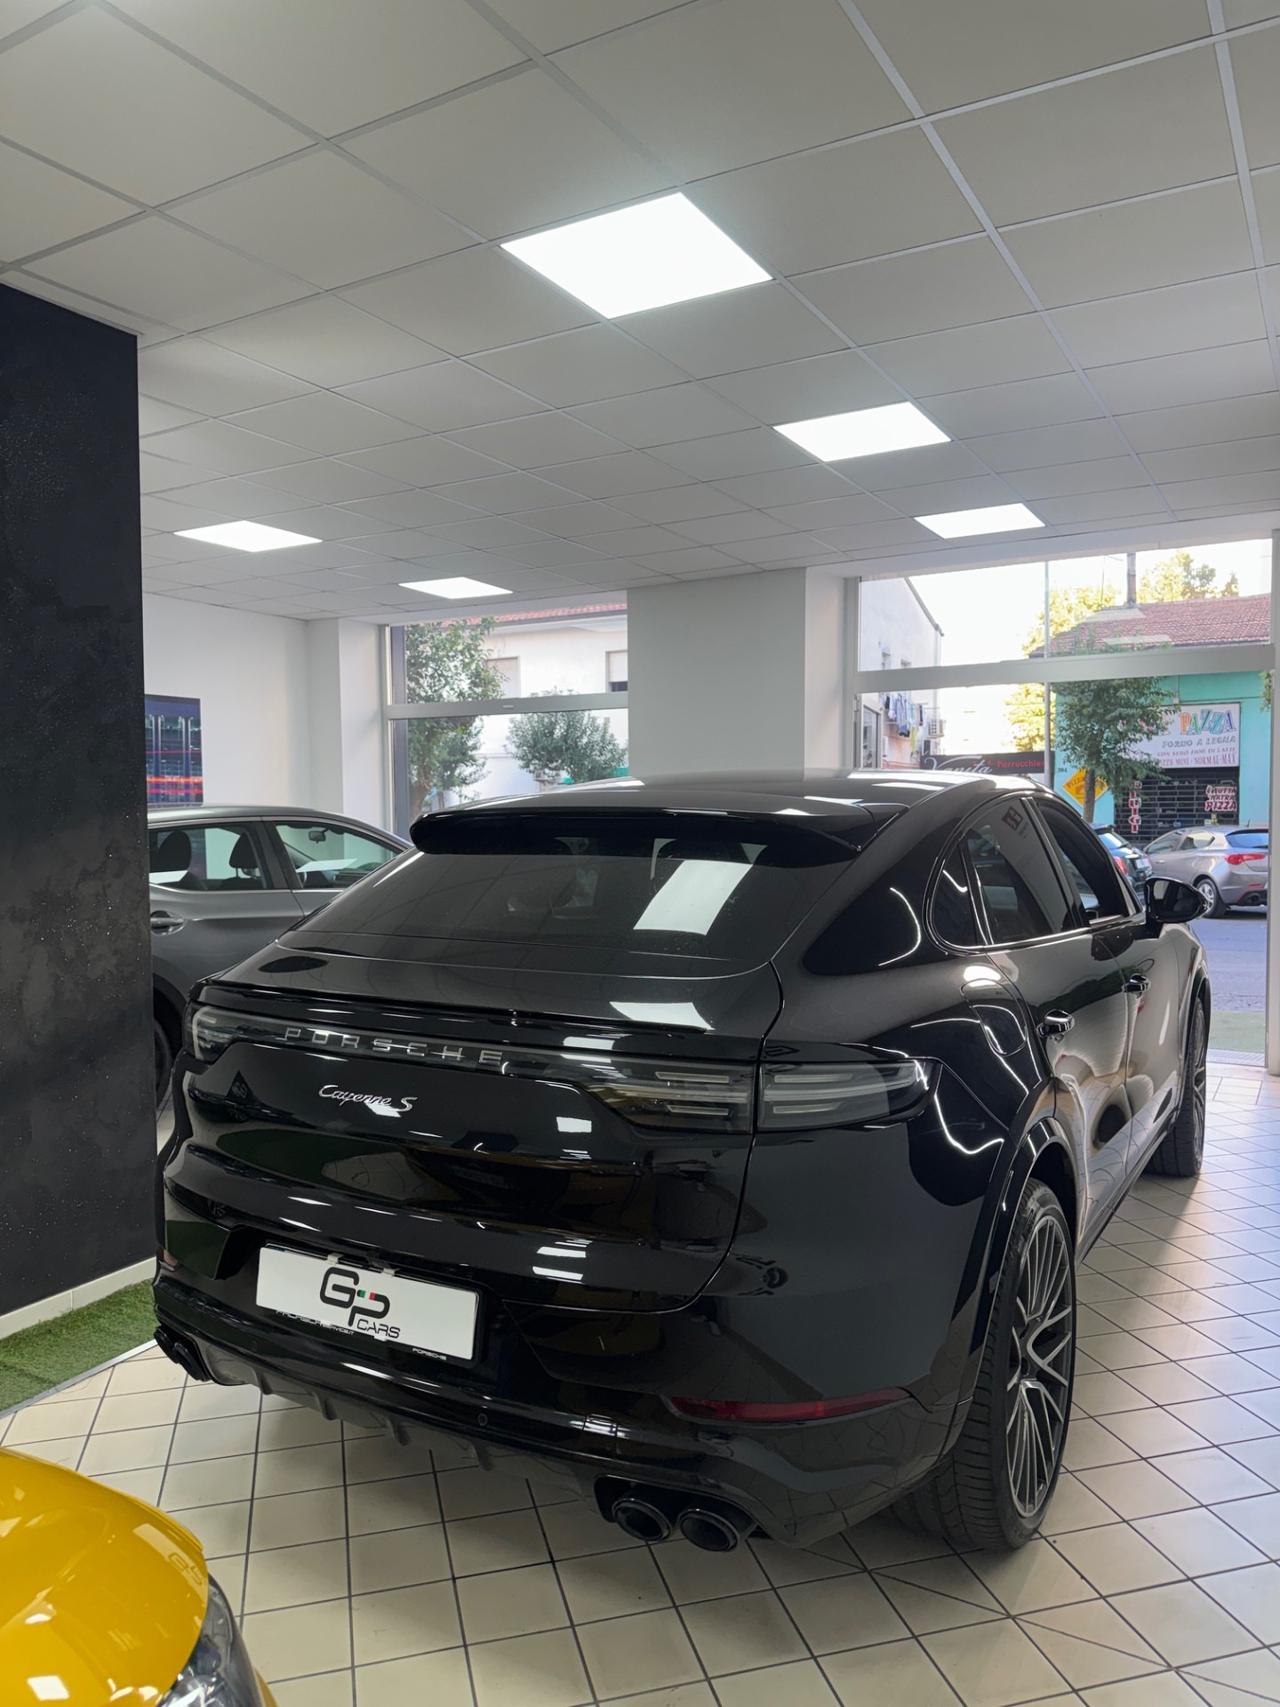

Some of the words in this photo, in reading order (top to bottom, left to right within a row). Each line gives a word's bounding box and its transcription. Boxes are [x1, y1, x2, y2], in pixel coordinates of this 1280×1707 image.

[285, 1027, 502, 1064] PORSCHE
[319, 1085, 391, 1106] Cayenne
[401, 1097, 418, 1112] S
[356, 1318, 401, 1339] CARS
